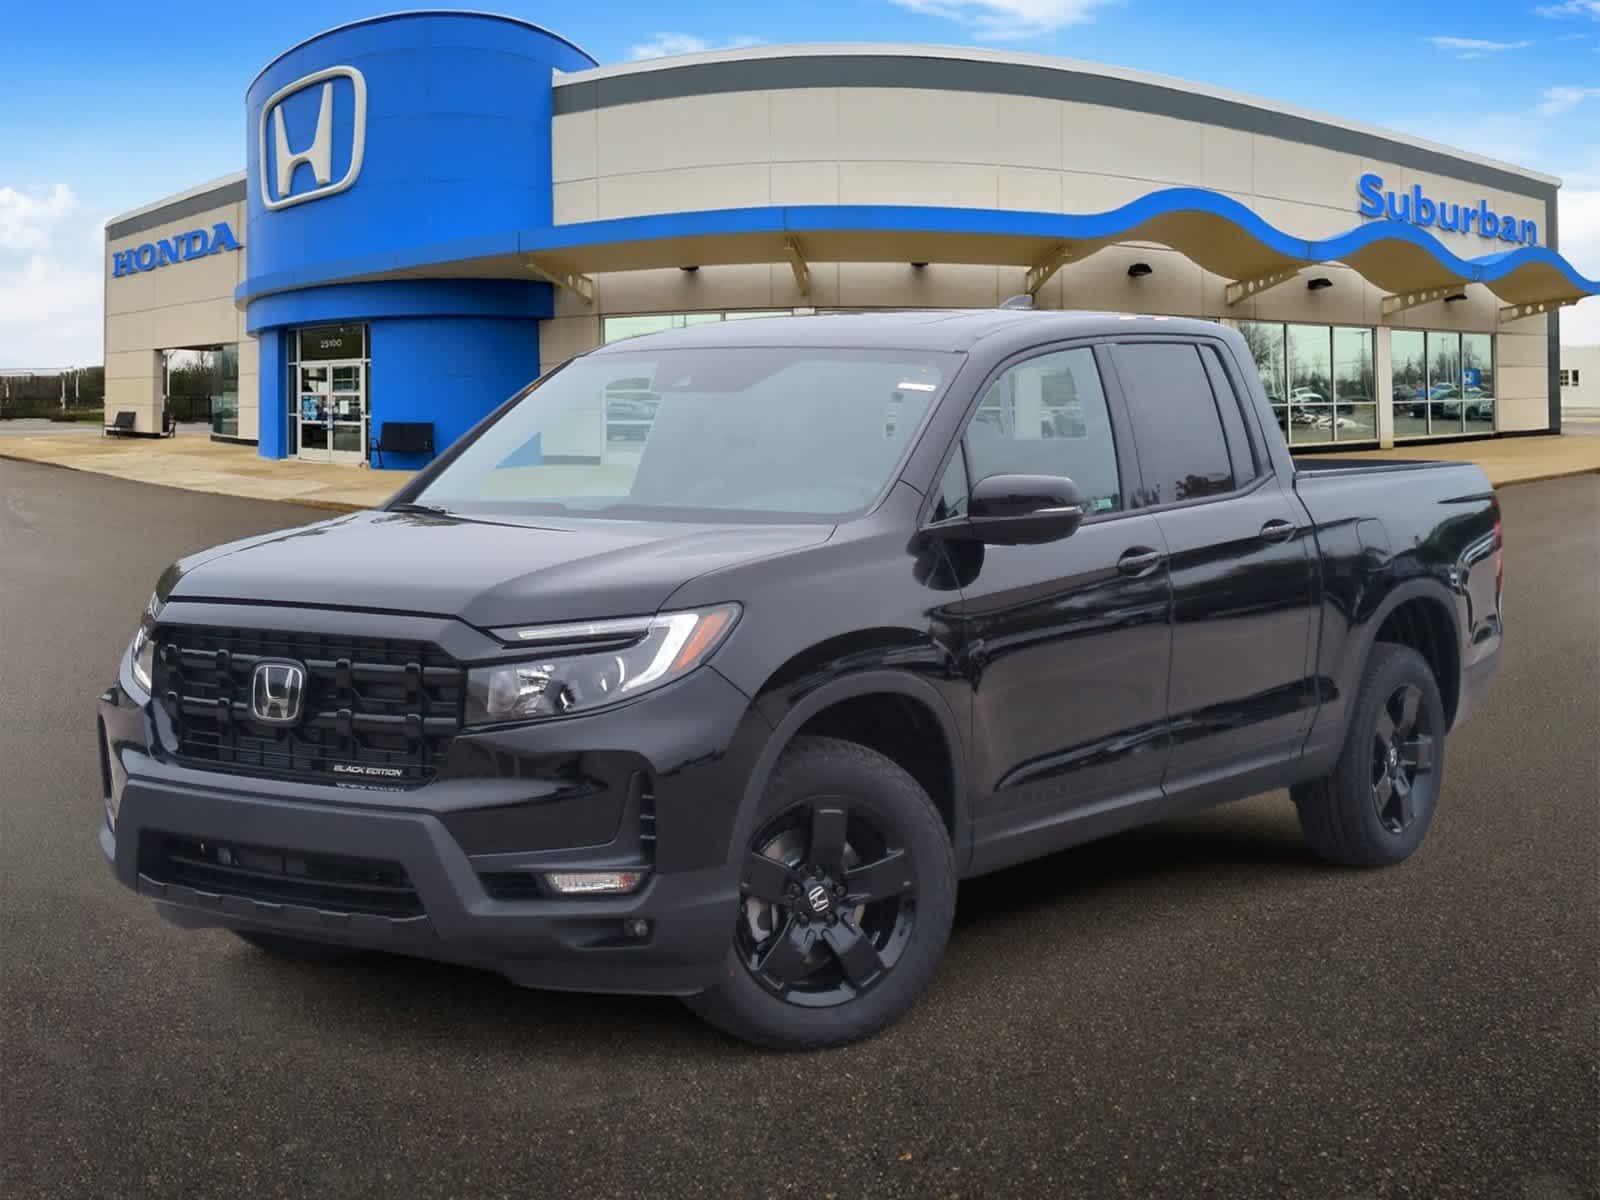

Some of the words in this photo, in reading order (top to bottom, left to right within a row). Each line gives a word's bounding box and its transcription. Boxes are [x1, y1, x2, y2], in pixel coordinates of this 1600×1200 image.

[1359, 173, 1538, 246] Suburban
[111, 221, 241, 278] HONDA
[333, 764, 365, 774] BLACK
[365, 767, 402, 777] EDITION
